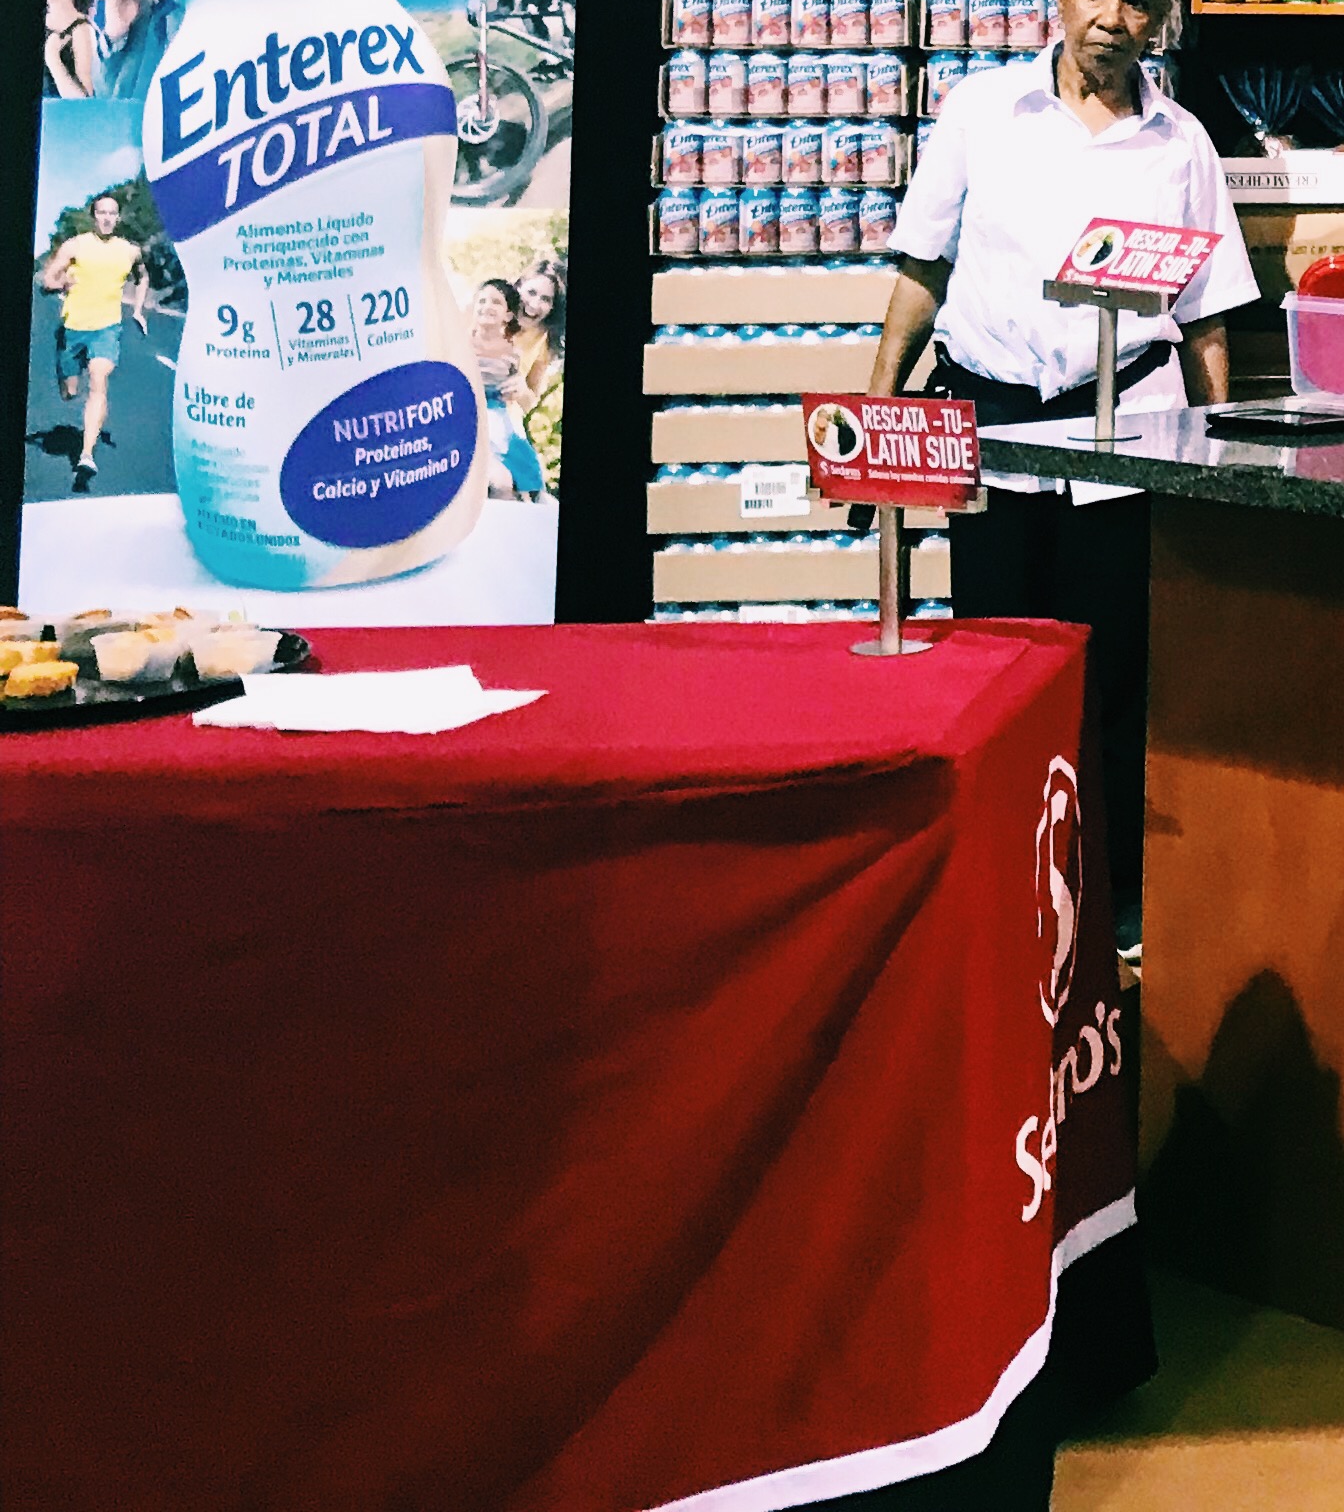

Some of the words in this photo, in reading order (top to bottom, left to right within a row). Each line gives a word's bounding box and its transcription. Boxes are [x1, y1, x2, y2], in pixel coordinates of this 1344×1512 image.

[158, 21, 426, 163] Enterex
[216, 93, 394, 209] TOTAL
[236, 221, 313, 239] Alimento
[312, 244, 386, 267] Vitaminas
[1106, 248, 1160, 278] LATIN
[1151, 254, 1201, 284] SIDE
[277, 264, 354, 286] Minerales
[295, 299, 336, 335] 28
[361, 286, 410, 326] 220
[288, 334, 350, 351] Vitaminas
[297, 346, 355, 363] Minerales
[184, 382, 229, 409] Libre
[235, 391, 256, 410] de
[186, 403, 247, 429] Gluten
[333, 391, 455, 444] NUTRIFORT
[860, 403, 930, 434] RESCATA
[863, 432, 922, 469] LATIN
[925, 435, 976, 472] SIDE
[312, 477, 368, 501] Calcio
[383, 456, 448, 489] Vitamina
[450, 449, 461, 470] D
